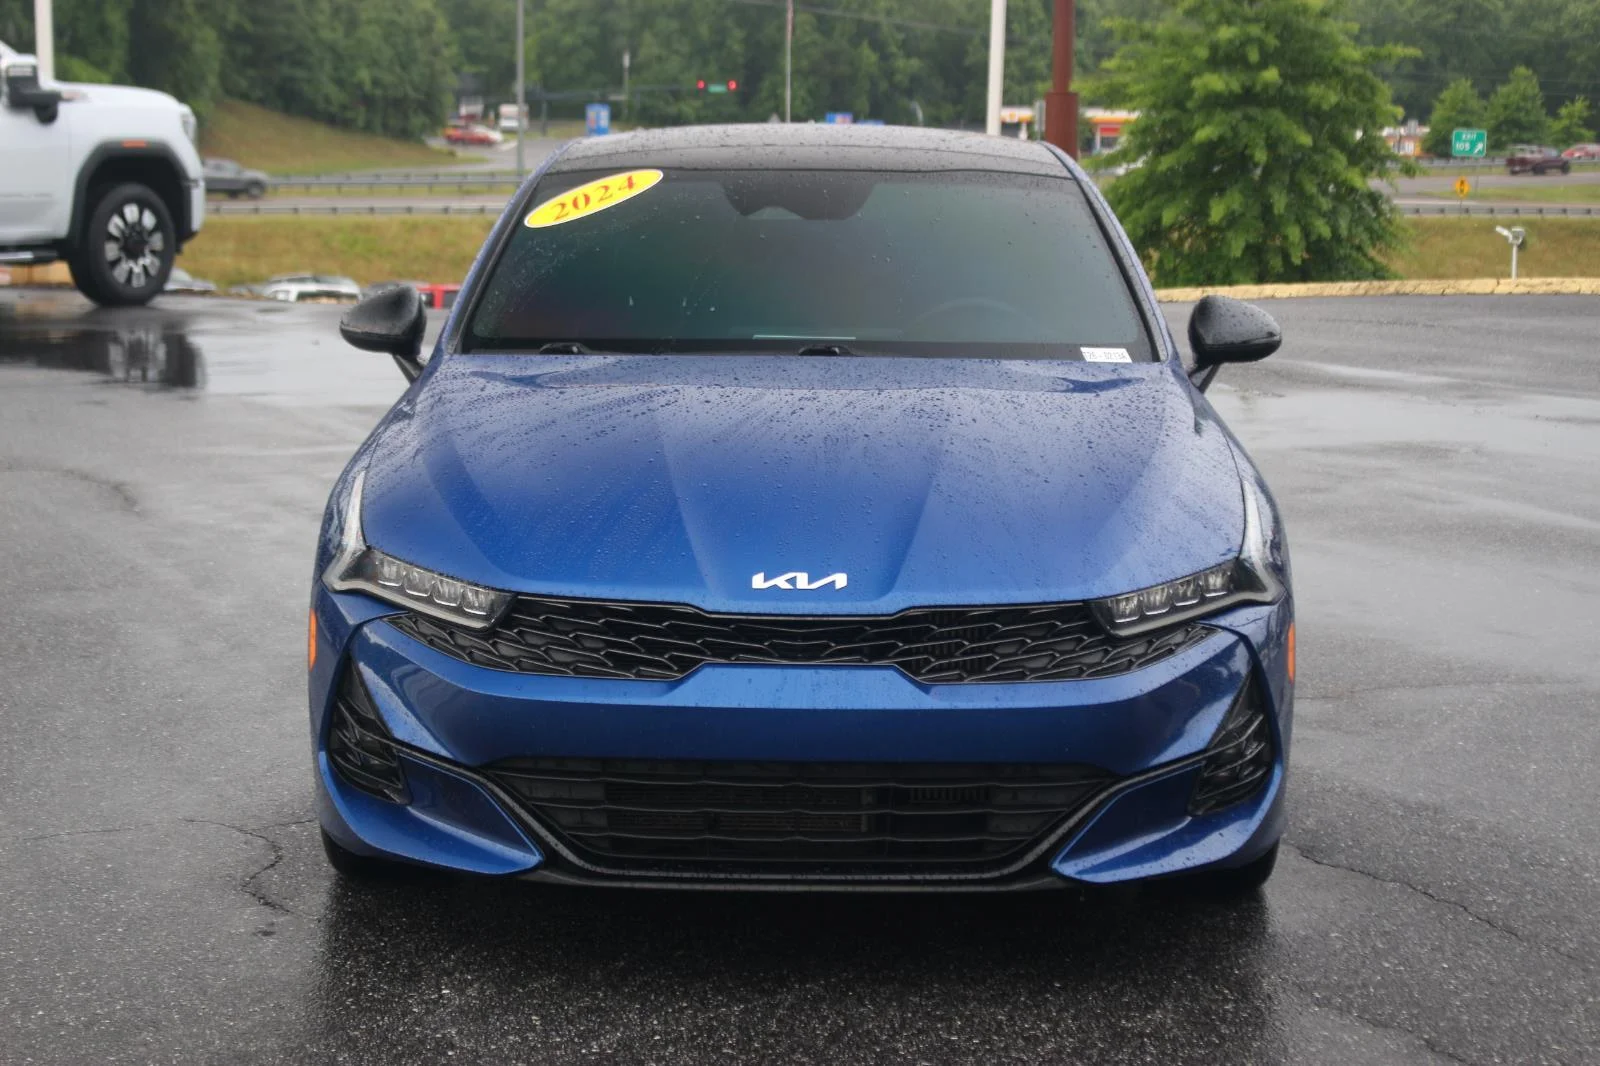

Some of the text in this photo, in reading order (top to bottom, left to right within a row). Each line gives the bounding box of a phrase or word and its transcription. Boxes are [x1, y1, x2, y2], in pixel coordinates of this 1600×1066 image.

[1462, 132, 1477, 141] EXIT
[550, 174, 636, 221] 2024
[751, 571, 848, 590] KIA
